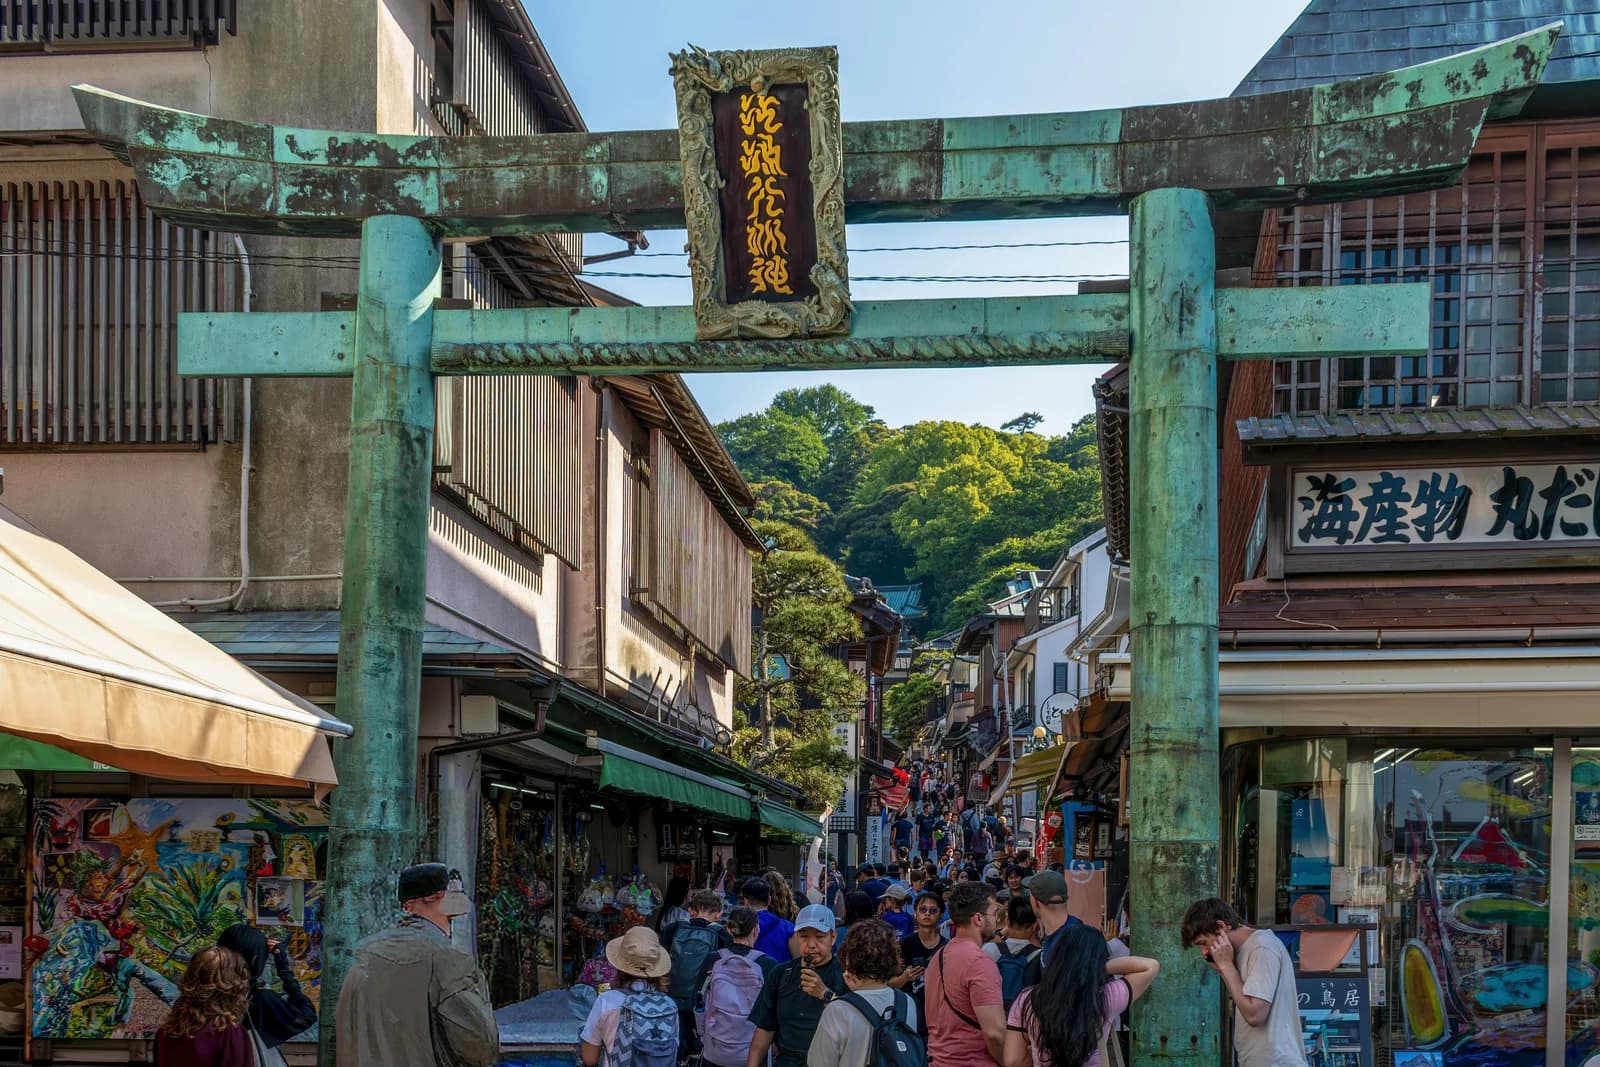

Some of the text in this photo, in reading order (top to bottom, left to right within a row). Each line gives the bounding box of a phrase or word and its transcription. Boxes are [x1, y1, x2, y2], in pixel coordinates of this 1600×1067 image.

[1297, 471, 1473, 545] 海産物
[1297, 989, 1360, 1007] の鳥居
